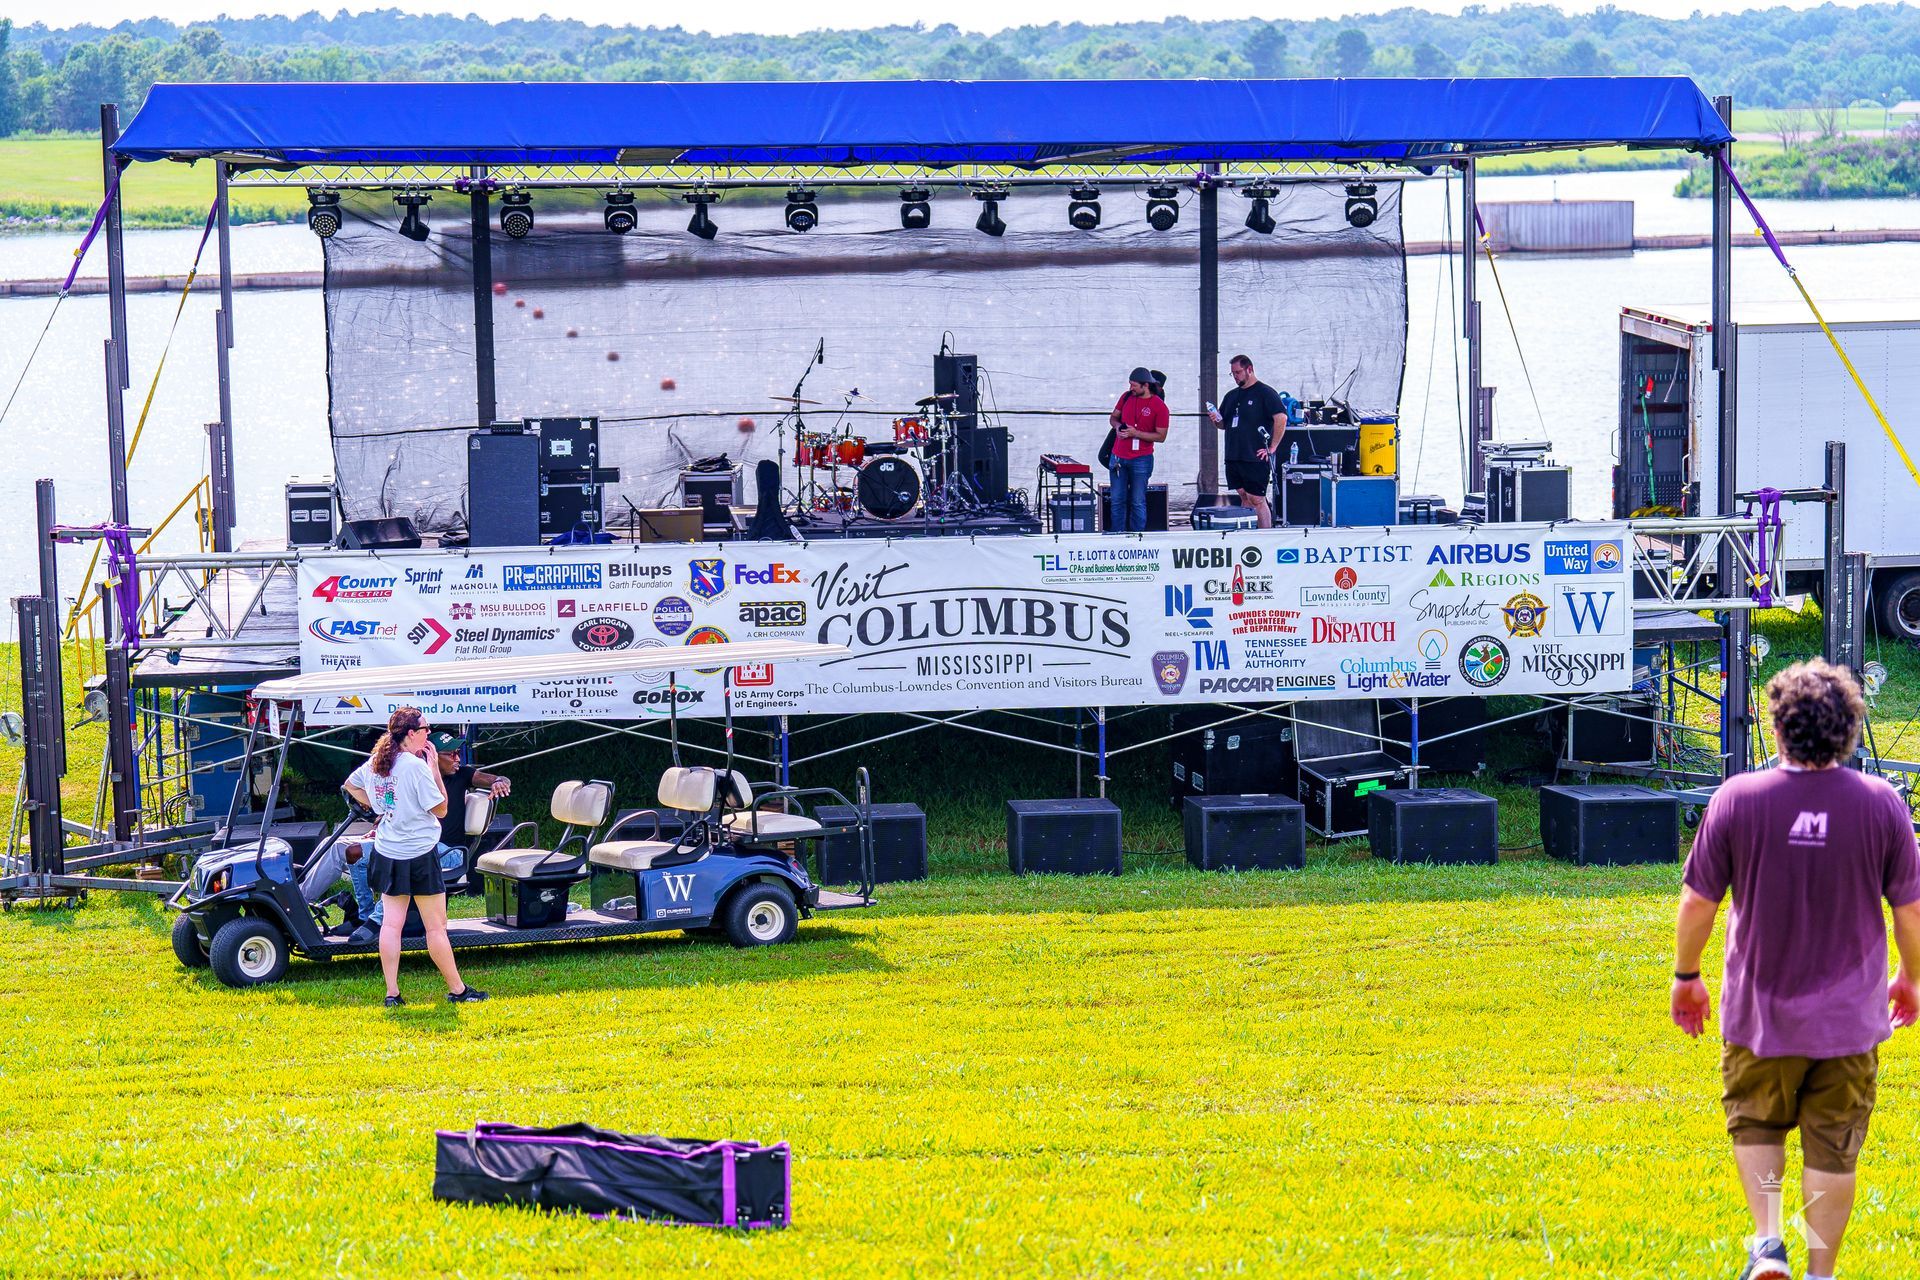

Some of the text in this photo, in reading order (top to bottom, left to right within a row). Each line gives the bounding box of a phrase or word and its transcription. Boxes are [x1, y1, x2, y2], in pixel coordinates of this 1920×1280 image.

[1087, 550, 1108, 560] LOTT
[1110, 550, 1116, 560] &
[1117, 549, 1160, 560] COMPANY
[1172, 547, 1232, 569] WCBI
[1304, 545, 1412, 564] BAPTIST
[1426, 543, 1531, 565] AIRBUS
[1546, 544, 1588, 557] United
[608, 563, 672, 579] Billups
[1069, 564, 1084, 573] CPAs
[1085, 564, 1094, 573] and
[1095, 564, 1114, 573] Business
[1115, 563, 1135, 572] Advisors
[1135, 563, 1148, 572] since
[1563, 557, 1588, 573] Way
[404, 567, 443, 585] Sprint
[735, 563, 801, 585] FedEx
[1461, 572, 1540, 587] REGIONS
[339, 575, 397, 589] COUNTY
[419, 584, 441, 594] Mart
[608, 580, 673, 590] Garth Foundation
[811, 562, 909, 611] Visit
[1204, 579, 1273, 595] CLARK
[1305, 589, 1386, 602] Lowndes County
[480, 603, 546, 612] MSU BULLDOG
[581, 602, 648, 613] LEARFIELD
[1409, 589, 1499, 626] Snapshot
[1562, 591, 1615, 634] W
[739, 605, 801, 627] apac
[817, 597, 1131, 648] COLUMBUS
[1229, 610, 1301, 621] LOWNDES COUNTY
[330, 620, 398, 635] FASTnet
[578, 618, 628, 631] CARL HOGAN
[1232, 625, 1298, 635] FIRE DEPARTMENT
[1311, 616, 1396, 644] DISPATCH
[406, 622, 430, 645] SDI
[455, 626, 555, 644] Steel Dynamics
[769, 630, 805, 638] COMPANY
[455, 645, 512, 654] Flat Roll Group
[1245, 639, 1307, 648] TENNESSEE
[1533, 644, 1563, 654] VISIT
[1192, 640, 1230, 671] TVA
[1245, 649, 1284, 658] VALLEY
[321, 659, 361, 671] THEATRE
[916, 653, 1033, 677] MISSISSIPPI
[1245, 659, 1306, 669] AUTHORITY
[1340, 657, 1417, 673] Columbus
[1522, 653, 1625, 687] MISSISSIPPI
[474, 684, 517, 695] Airport
[805, 675, 1143, 694] The Columbus-Lowndes Convention and Visitors Bureau
[1200, 675, 1336, 693] PACCAR ENGINES
[532, 687, 618, 698] Parlor House
[750, 690, 774, 699] Army
[777, 689, 805, 698] Corps
[441, 704, 454, 713] Jo
[456, 703, 487, 713] Anne
[489, 702, 520, 712] Leike
[734, 700, 744, 708] of
[662, 873, 697, 902] W
